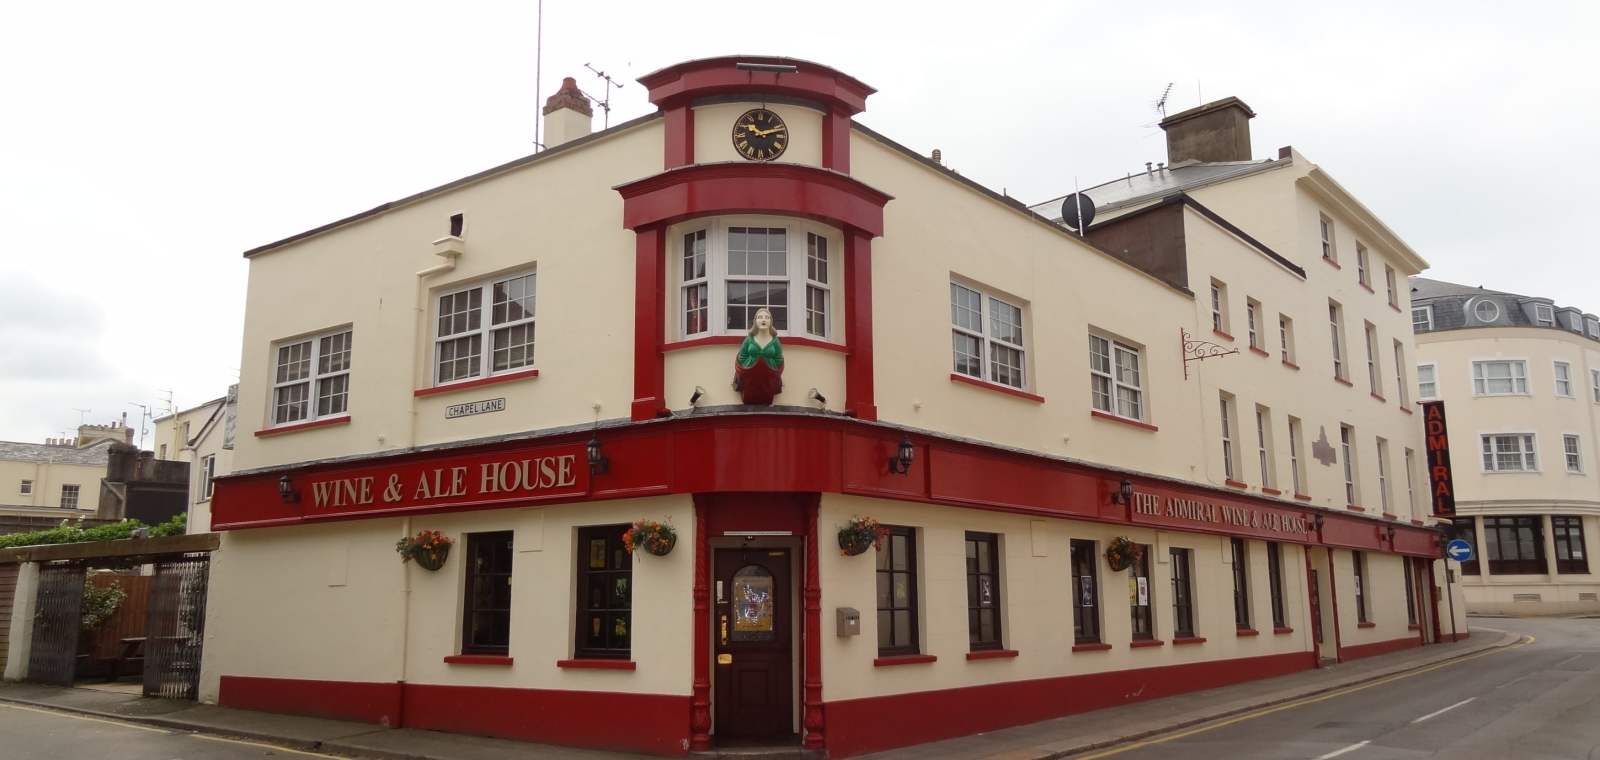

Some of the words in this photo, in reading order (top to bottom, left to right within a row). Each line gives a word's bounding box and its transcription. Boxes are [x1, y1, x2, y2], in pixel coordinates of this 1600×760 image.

[449, 404, 478, 417] CHAPEL
[481, 400, 502, 412] LANE
[312, 476, 375, 508] WINE
[383, 473, 403, 503] &
[413, 467, 467, 500] ALE
[478, 454, 576, 494] HOUSE
[1428, 405, 1452, 513] ADMIRAL
[1133, 491, 1160, 516] THE
[1165, 497, 1219, 523] ADMIRAL
[1222, 504, 1250, 527] WINE
[1250, 509, 1259, 529] &
[1262, 511, 1280, 532] ALE
[1281, 513, 1309, 535] HOUSE
